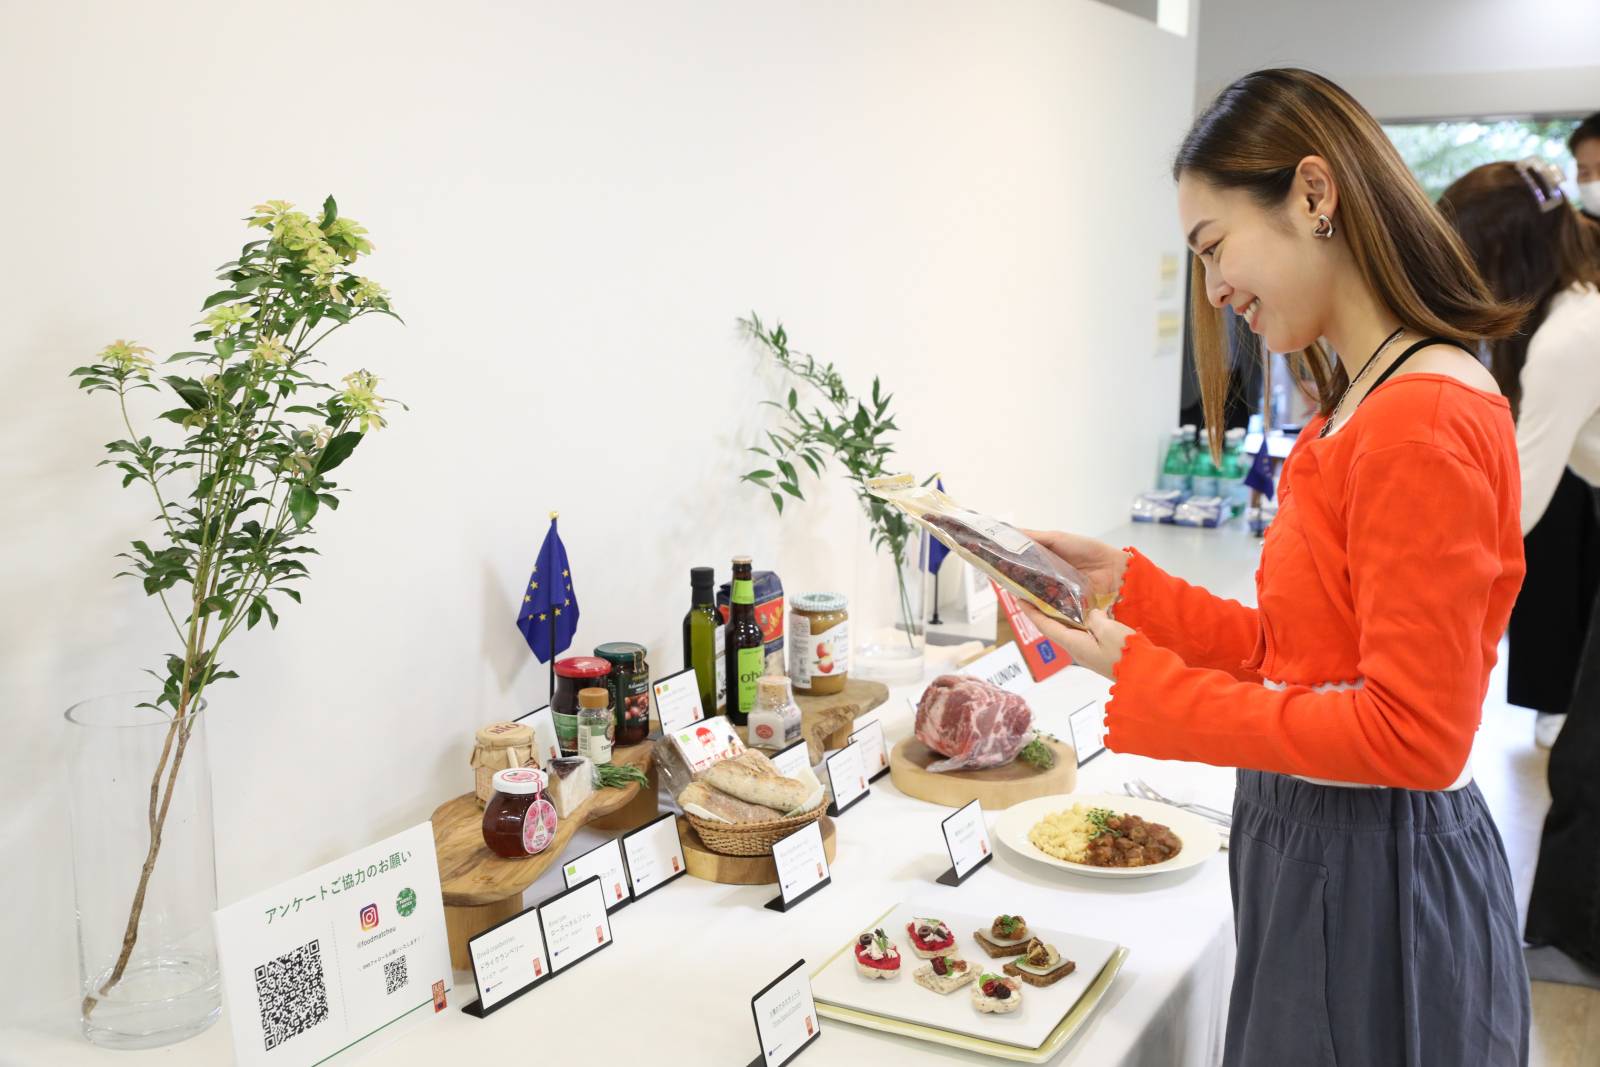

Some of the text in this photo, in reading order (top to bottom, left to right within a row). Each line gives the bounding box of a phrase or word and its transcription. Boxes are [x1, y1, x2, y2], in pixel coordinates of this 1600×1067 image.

[996, 664, 1022, 685] UNION
[265, 849, 412, 925] アンケートご協力のお願い
